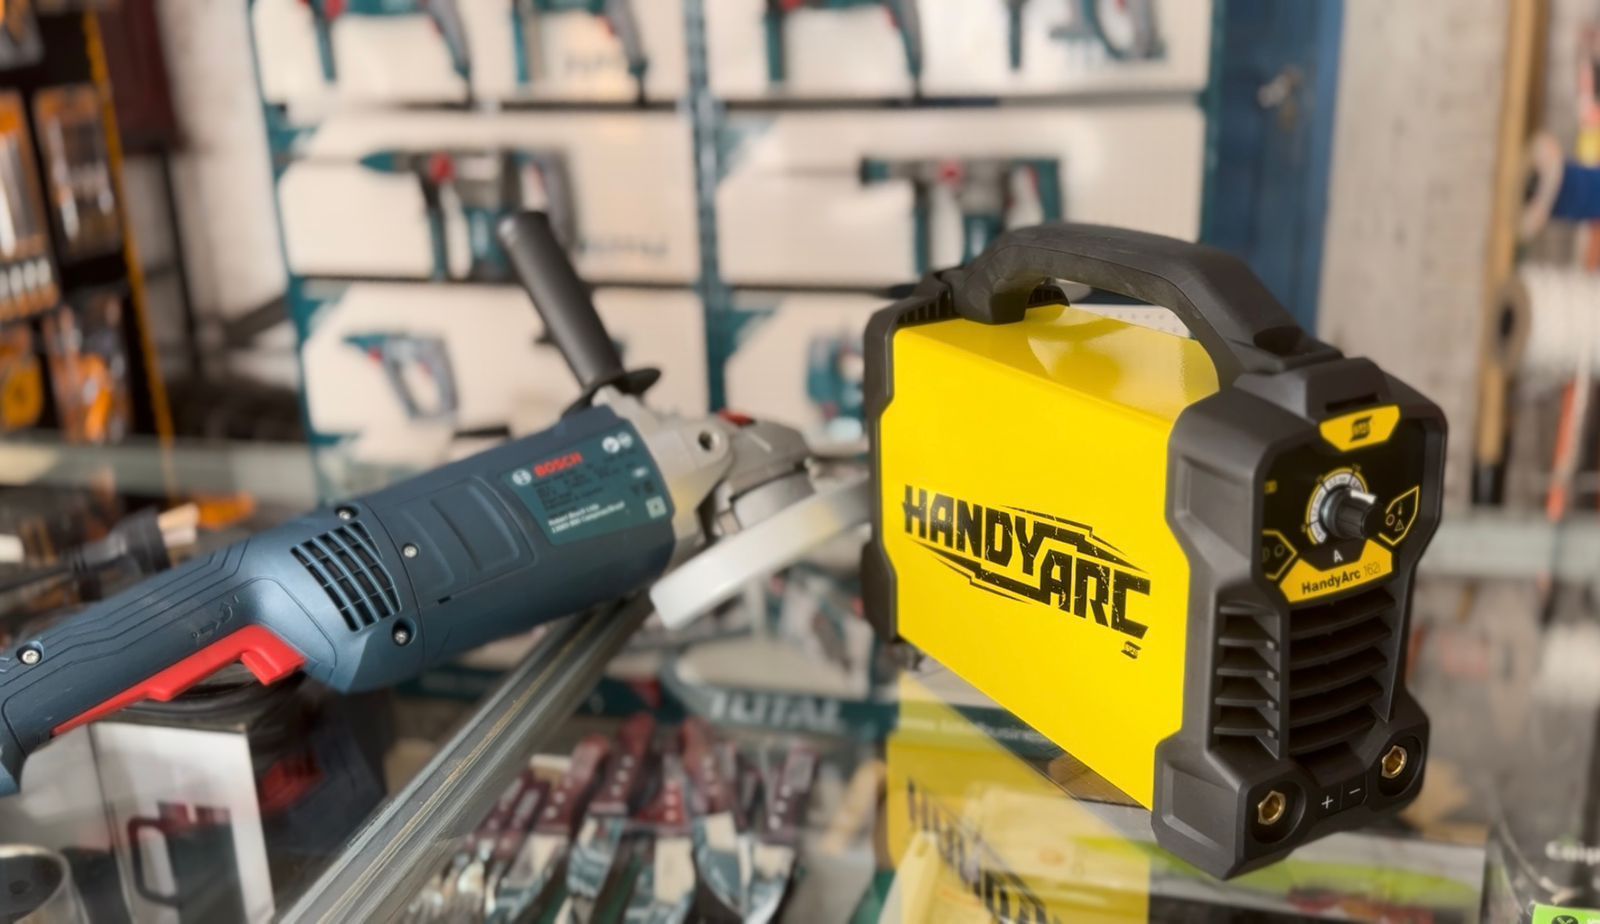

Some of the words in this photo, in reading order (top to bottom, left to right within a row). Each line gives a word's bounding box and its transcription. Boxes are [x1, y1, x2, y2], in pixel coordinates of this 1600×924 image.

[534, 452, 583, 478] BOSCH
[1333, 550, 1343, 562] A
[1302, 569, 1361, 595] HandyArc
